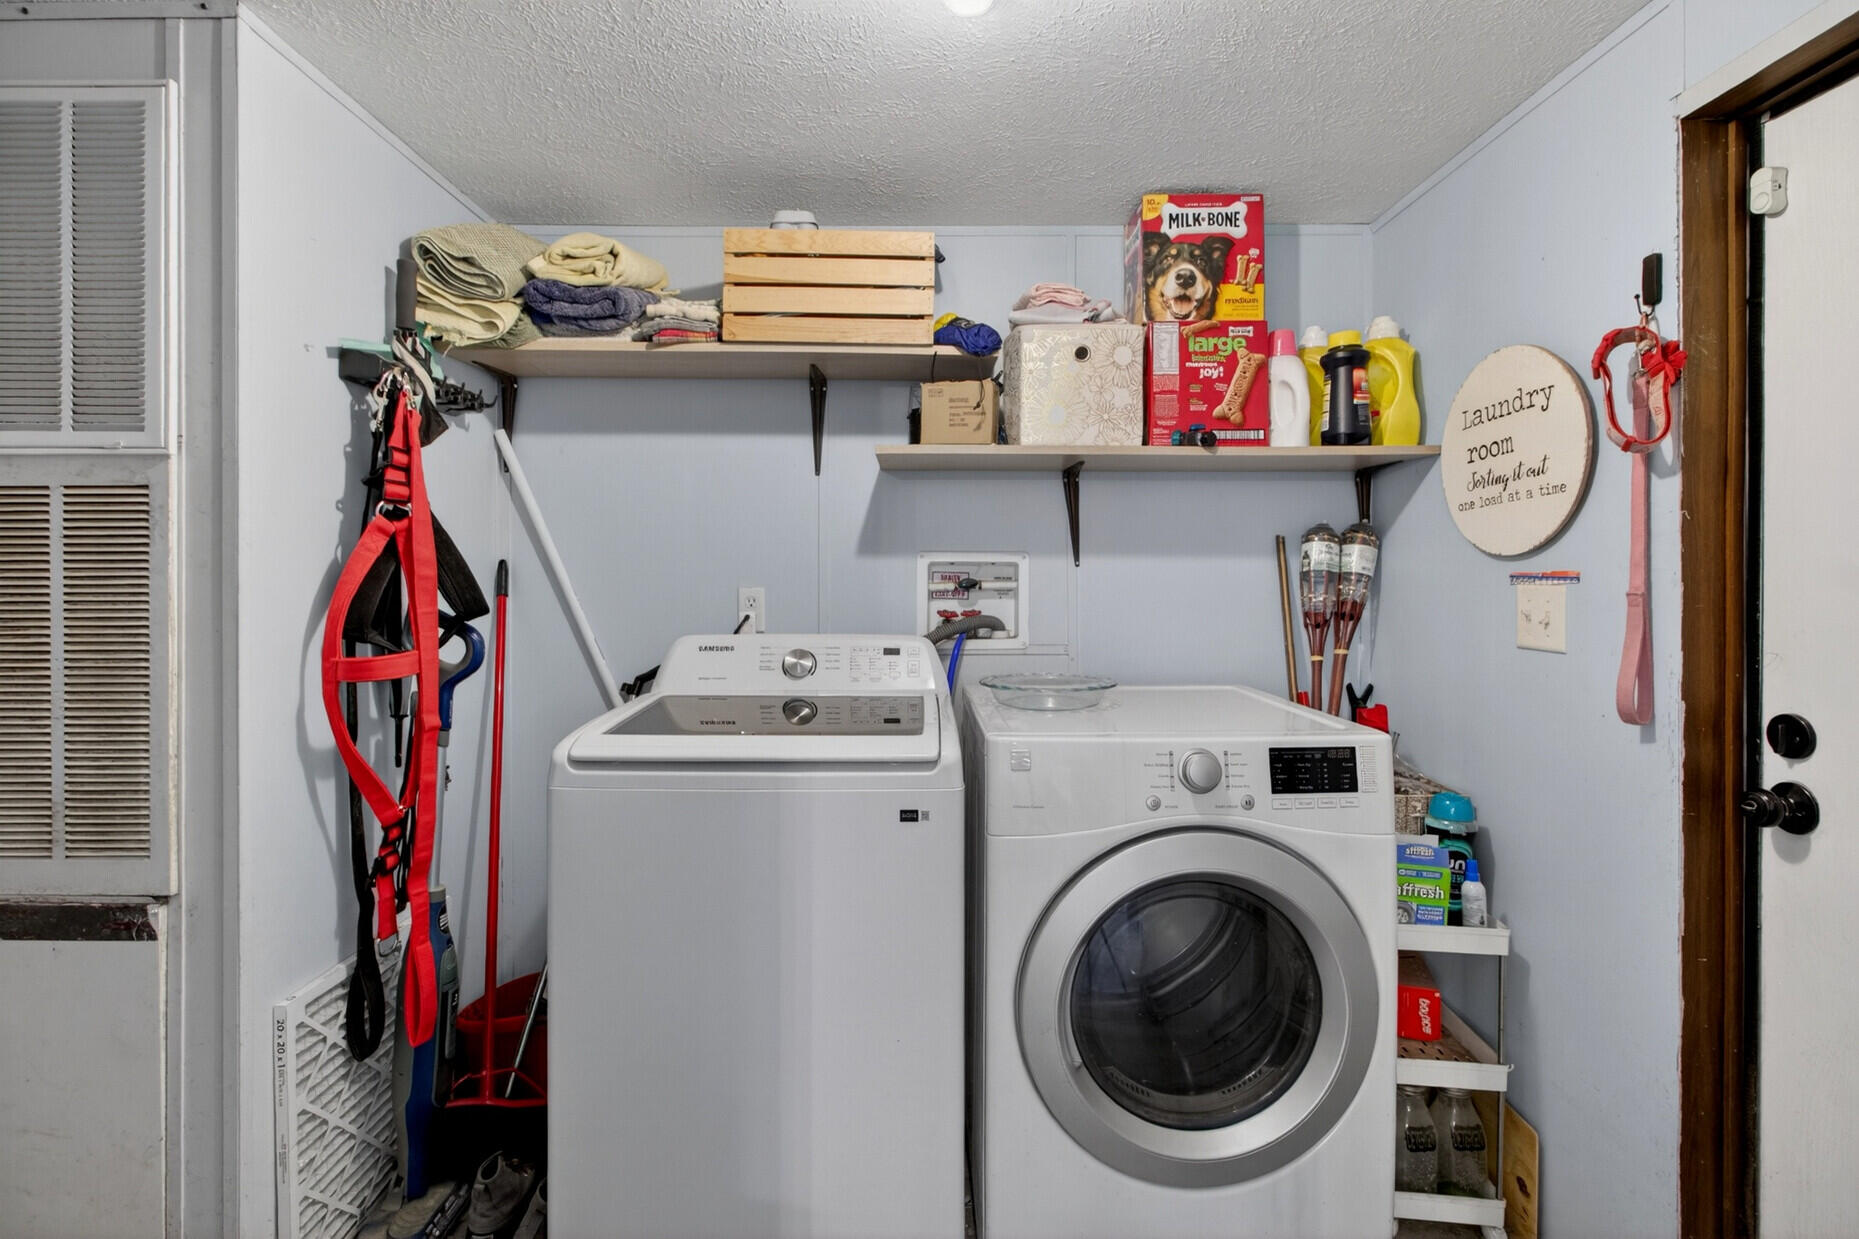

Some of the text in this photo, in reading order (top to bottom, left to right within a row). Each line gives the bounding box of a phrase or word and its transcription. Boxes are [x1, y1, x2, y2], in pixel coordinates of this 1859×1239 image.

[1188, 335, 1247, 356] large
[1199, 366, 1224, 379] joy!
[1462, 384, 1555, 431] Laundry
[1467, 436, 1515, 464] room
[1467, 454, 1550, 492] Sorting it out
[1458, 481, 1567, 512] one load at a time
[276, 1019, 285, 1032] 20
[276, 1042, 286, 1054] 20
